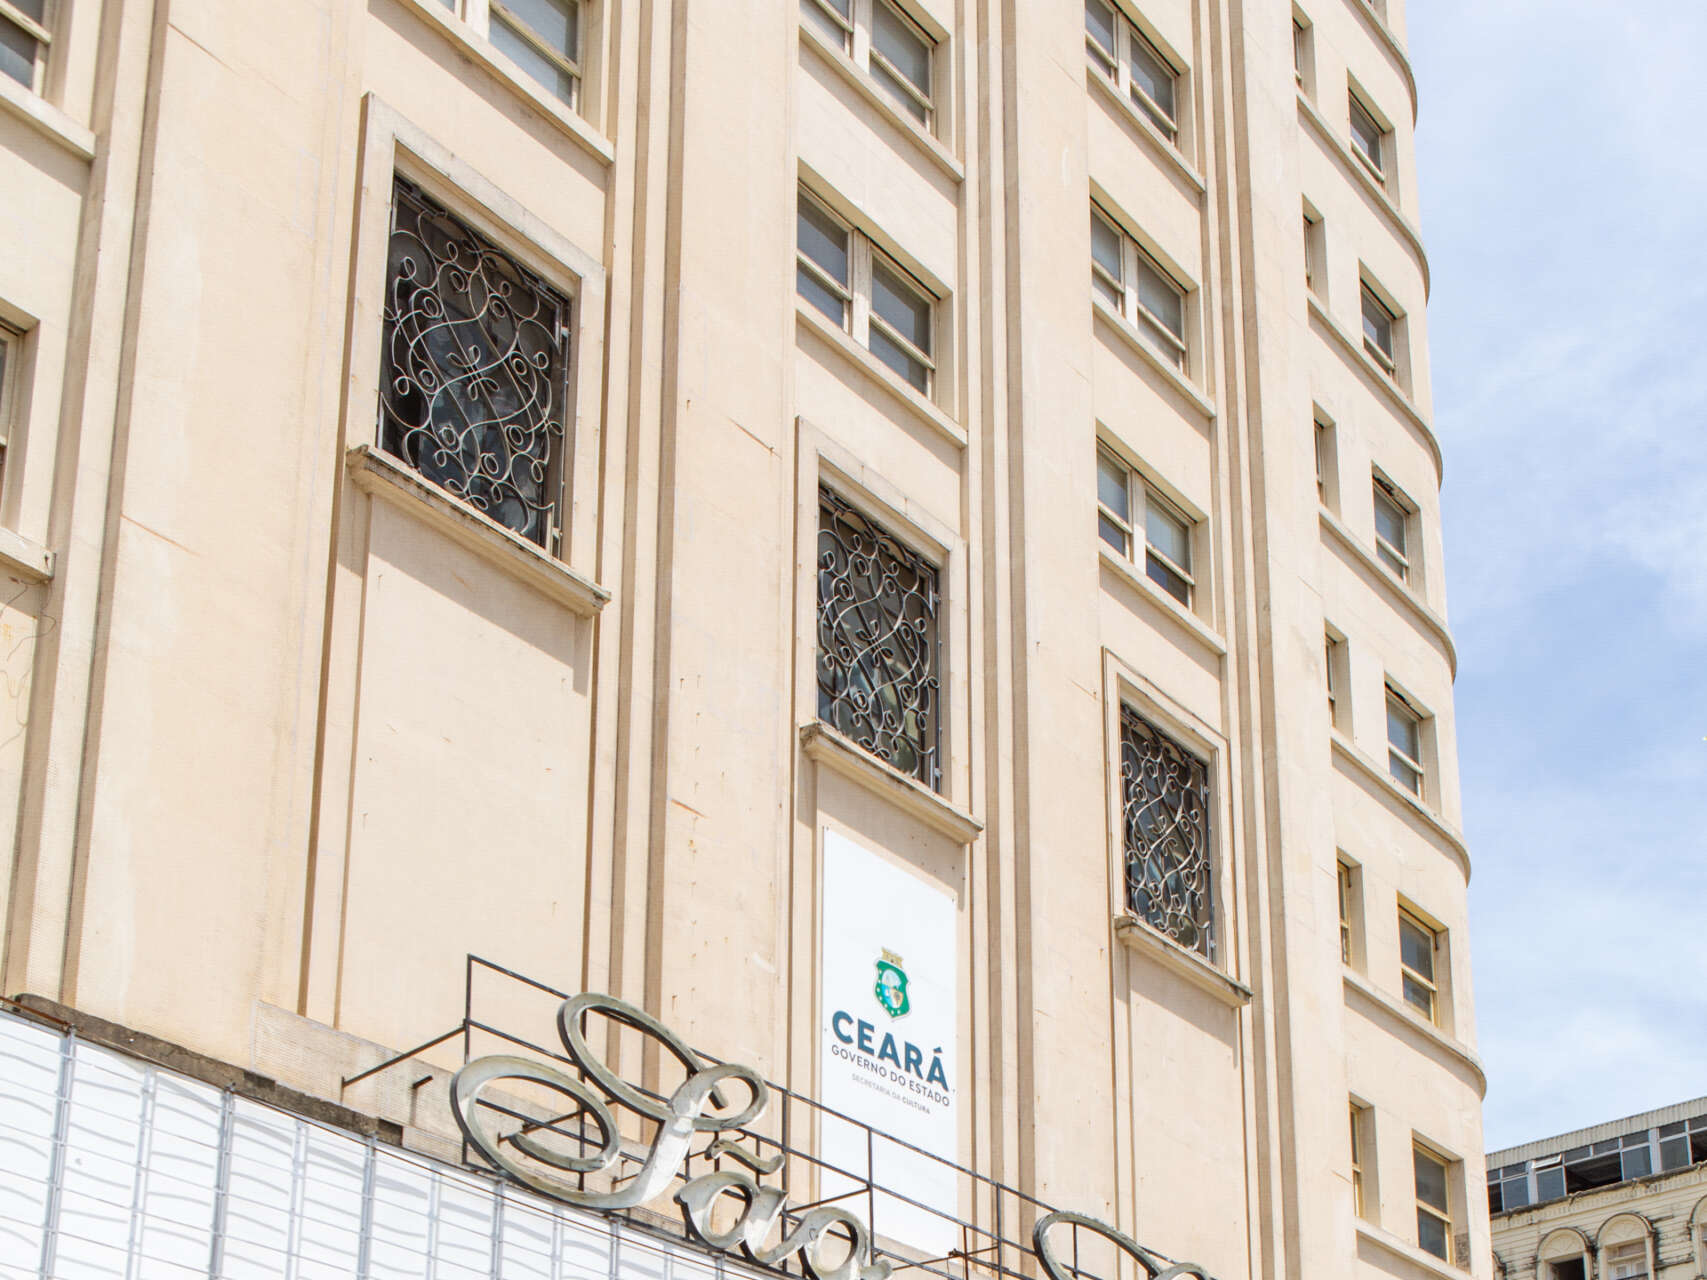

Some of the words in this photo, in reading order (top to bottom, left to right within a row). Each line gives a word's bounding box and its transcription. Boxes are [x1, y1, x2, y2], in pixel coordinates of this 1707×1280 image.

[831, 1044, 887, 1077] GOVERNO
[890, 1071, 906, 1086] DO
[909, 1080, 950, 1107] ESTADO
[832, 1010, 949, 1092] CEARÁ
[902, 1096, 930, 1115] CULTURA
